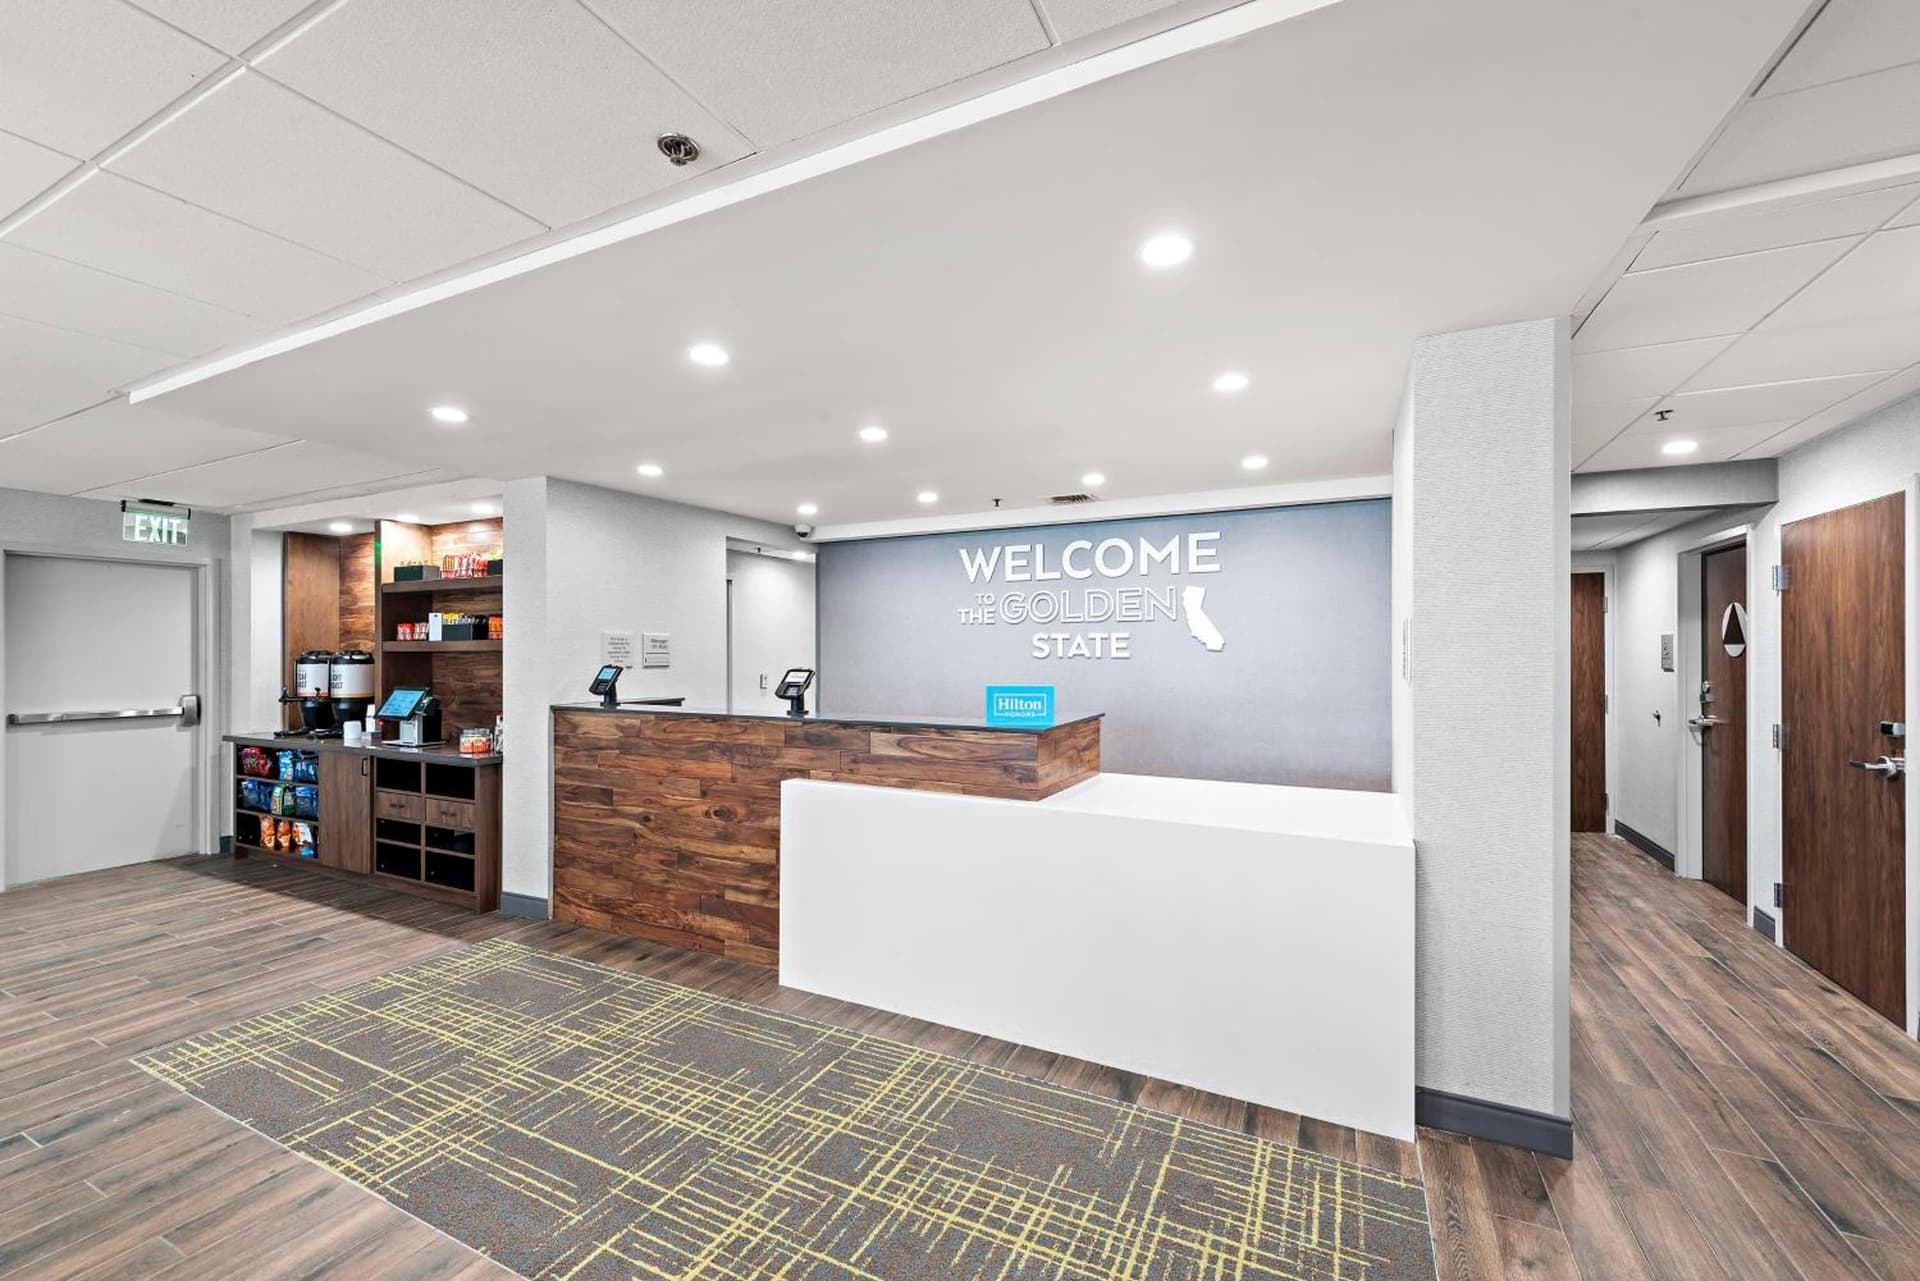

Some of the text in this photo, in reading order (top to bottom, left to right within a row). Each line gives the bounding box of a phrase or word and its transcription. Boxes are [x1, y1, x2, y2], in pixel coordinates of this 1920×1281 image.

[134, 514, 181, 545] EXIT
[959, 531, 1221, 583] WELCOME
[957, 585, 1177, 624] THE GOLDEN
[976, 593, 995, 606] TO
[1031, 632, 1131, 660] STATE
[998, 697, 1042, 711] Hilton
